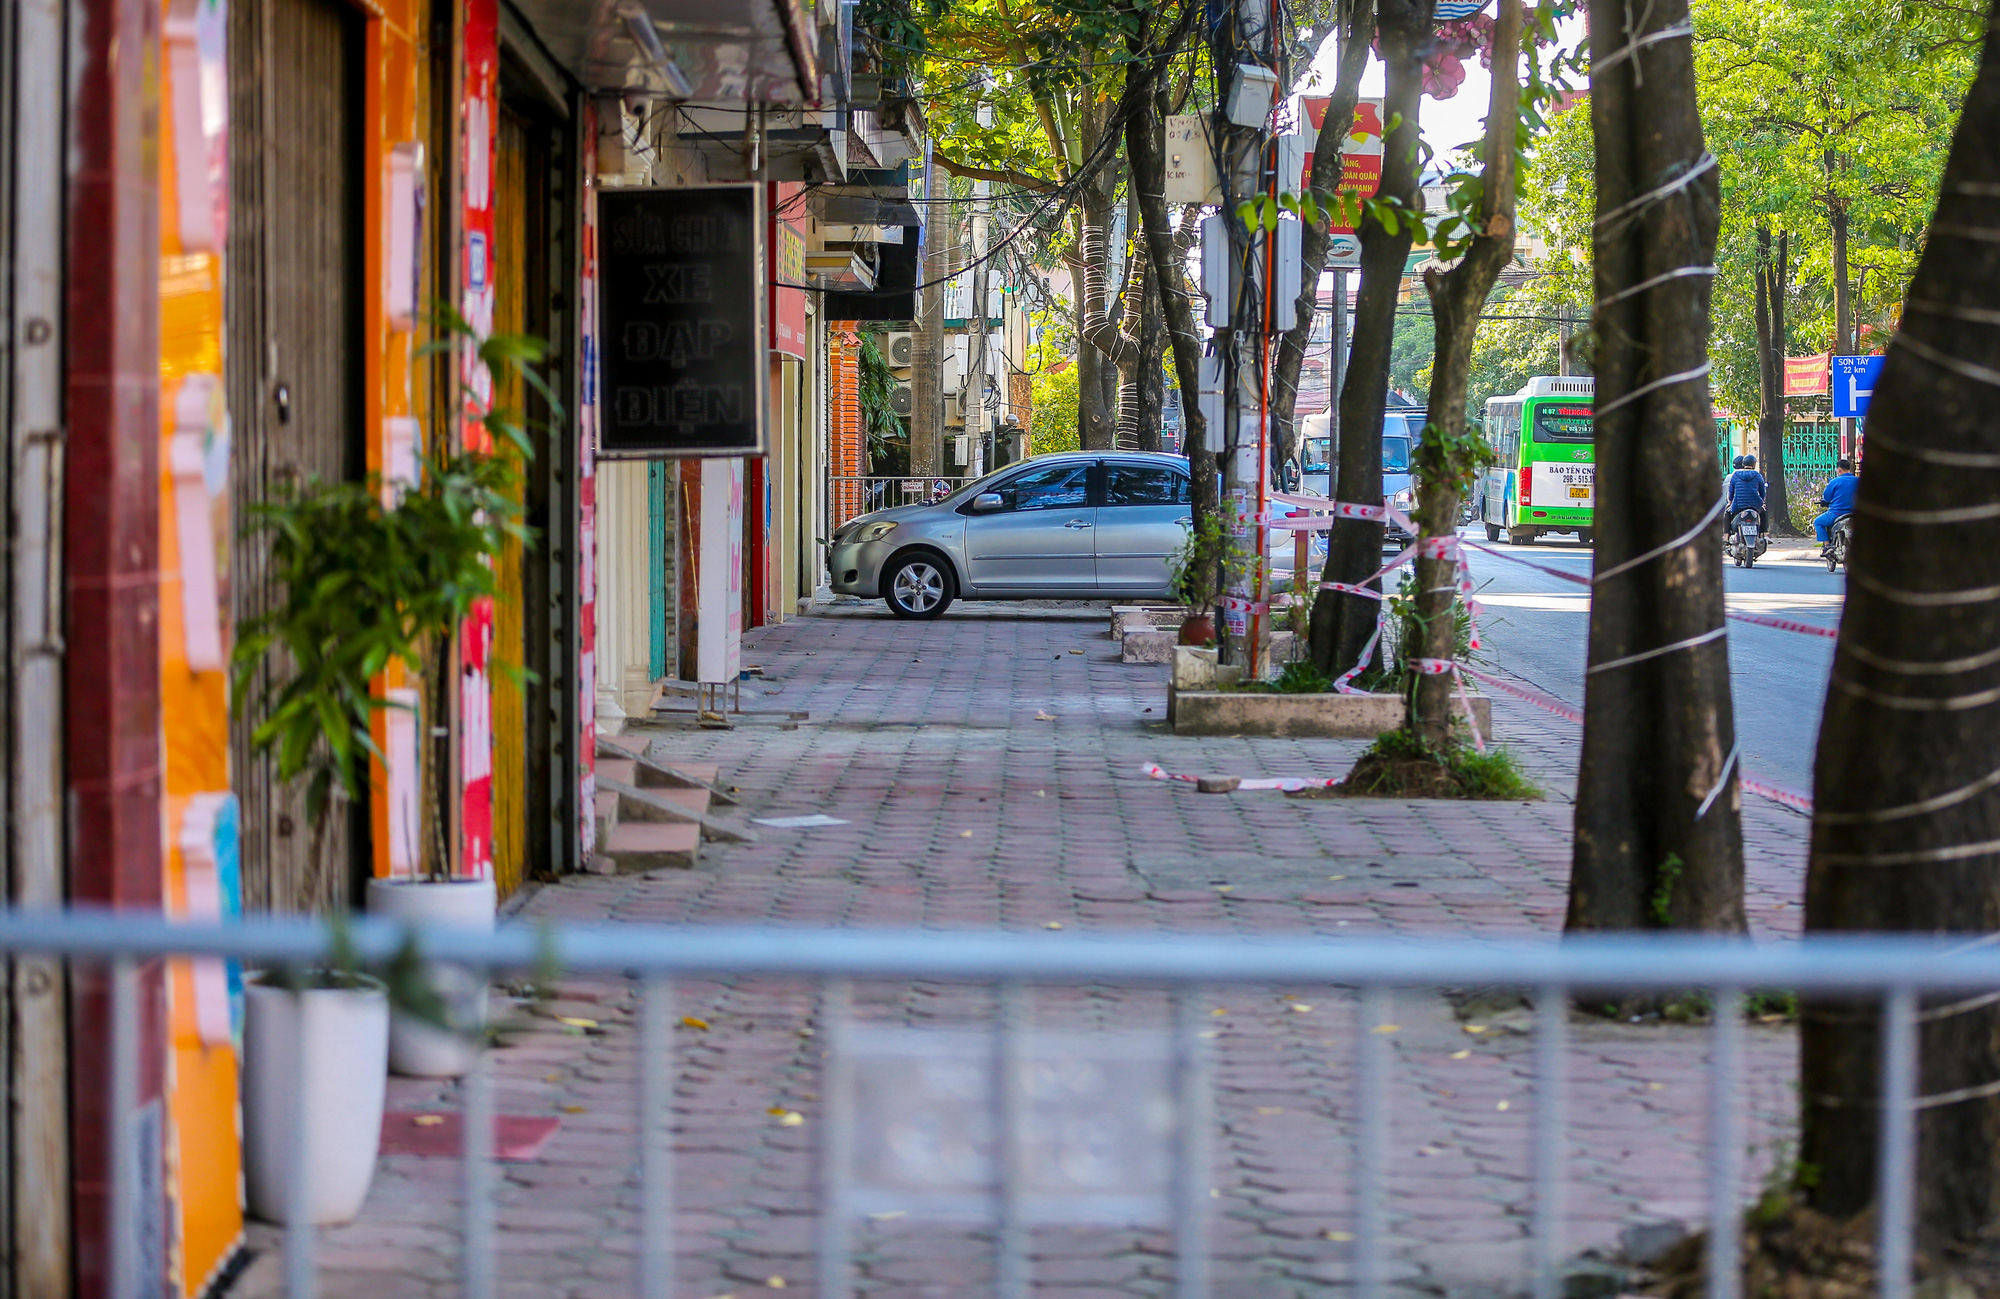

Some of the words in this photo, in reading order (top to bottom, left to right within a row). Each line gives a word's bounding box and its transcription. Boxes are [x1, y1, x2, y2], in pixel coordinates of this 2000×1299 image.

[1341, 171, 1358, 180] OÀN
[643, 263, 713, 304] XE
[622, 319, 734, 369] ĐẠP
[1838, 358, 1854, 366] SƠN
[1856, 355, 1870, 366] TÂY
[1843, 366, 1852, 374] 22
[1854, 366, 1866, 374] km
[614, 376, 744, 435] ĐIỆN
[1549, 464, 1564, 474] BẢO
[1565, 464, 1581, 475] YẾN
[1562, 475, 1573, 483] 29B
[1577, 476, 1595, 484] 515.1
